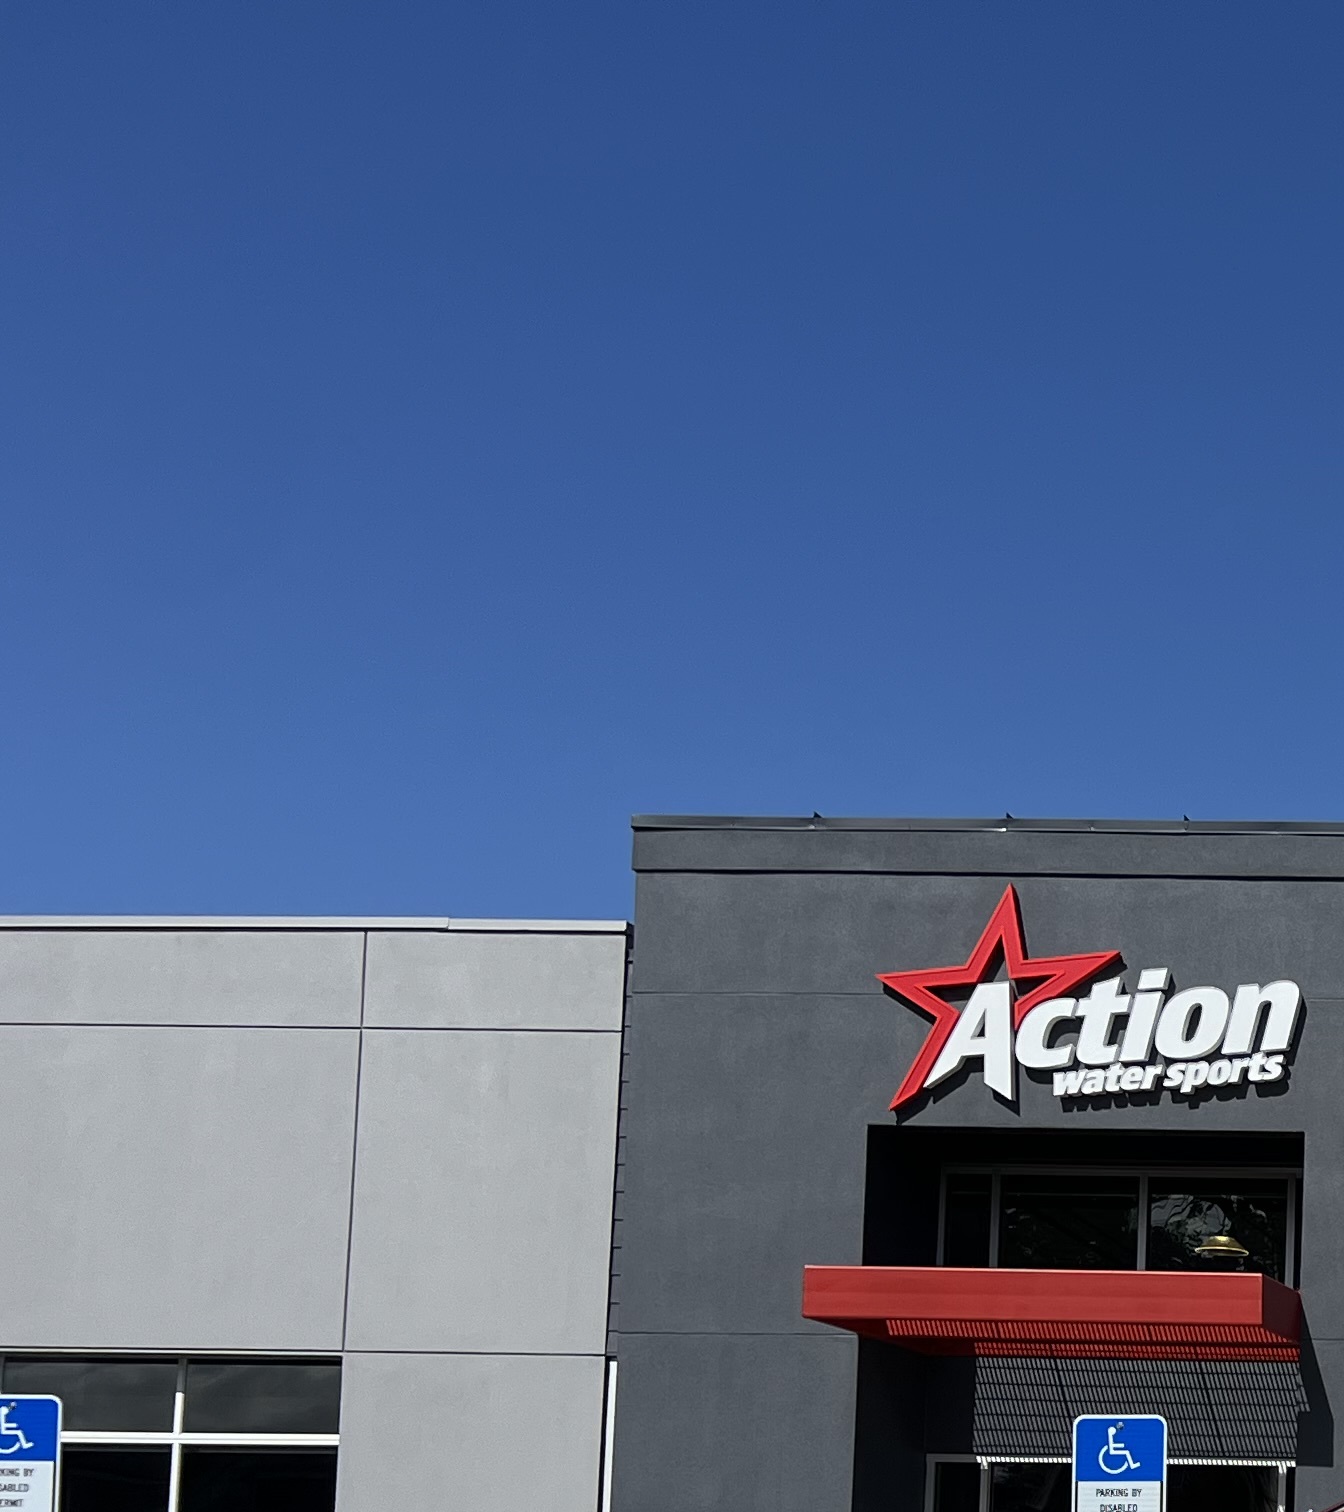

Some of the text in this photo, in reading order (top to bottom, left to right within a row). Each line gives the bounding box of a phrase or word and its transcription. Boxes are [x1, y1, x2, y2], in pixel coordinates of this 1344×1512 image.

[923, 968, 1301, 1100] Action
[23, 1468, 35, 1477] BY
[1095, 1488, 1142, 1498] PARKING BY
[1099, 1503, 1138, 1512] DISABLED
